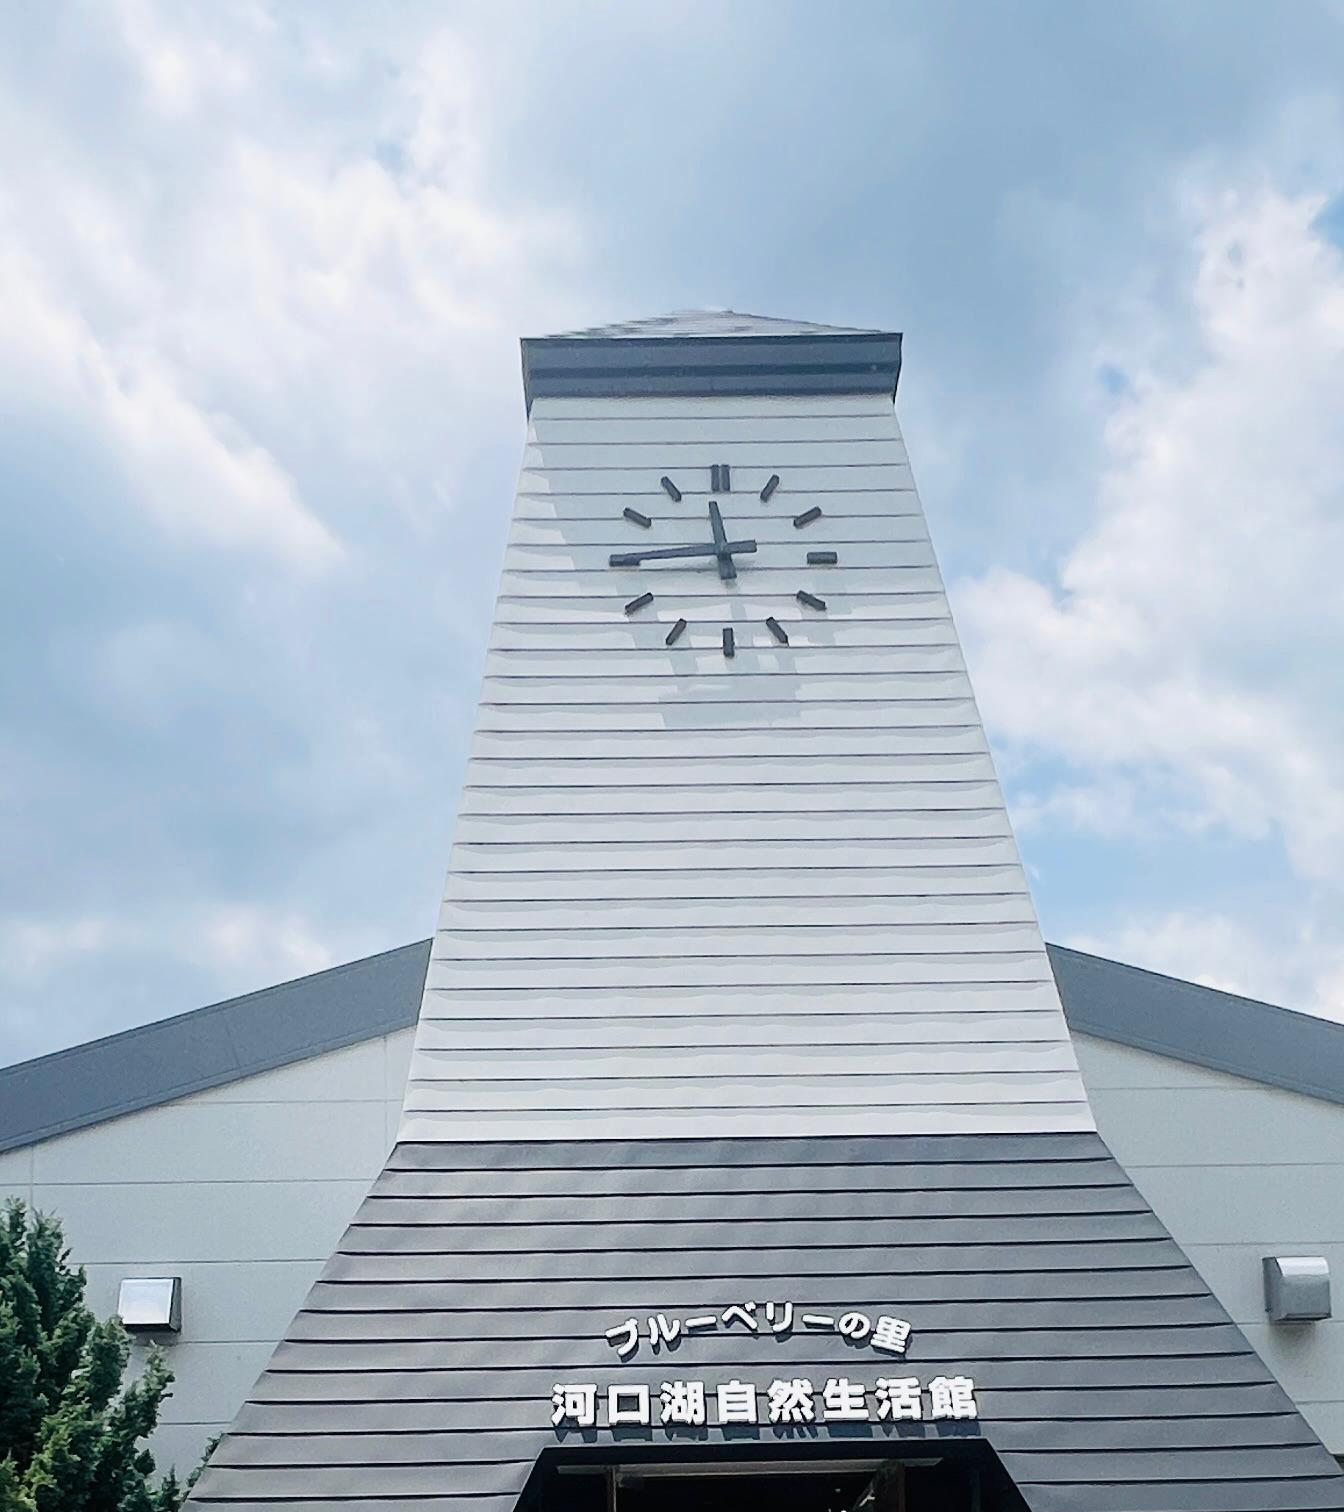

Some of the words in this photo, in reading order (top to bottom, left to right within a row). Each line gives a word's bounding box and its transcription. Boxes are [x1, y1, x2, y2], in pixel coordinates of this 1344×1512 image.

[605, 1302, 913, 1357] ブルーベリーの里
[551, 1376, 978, 1426] 河口湖自然生活館
